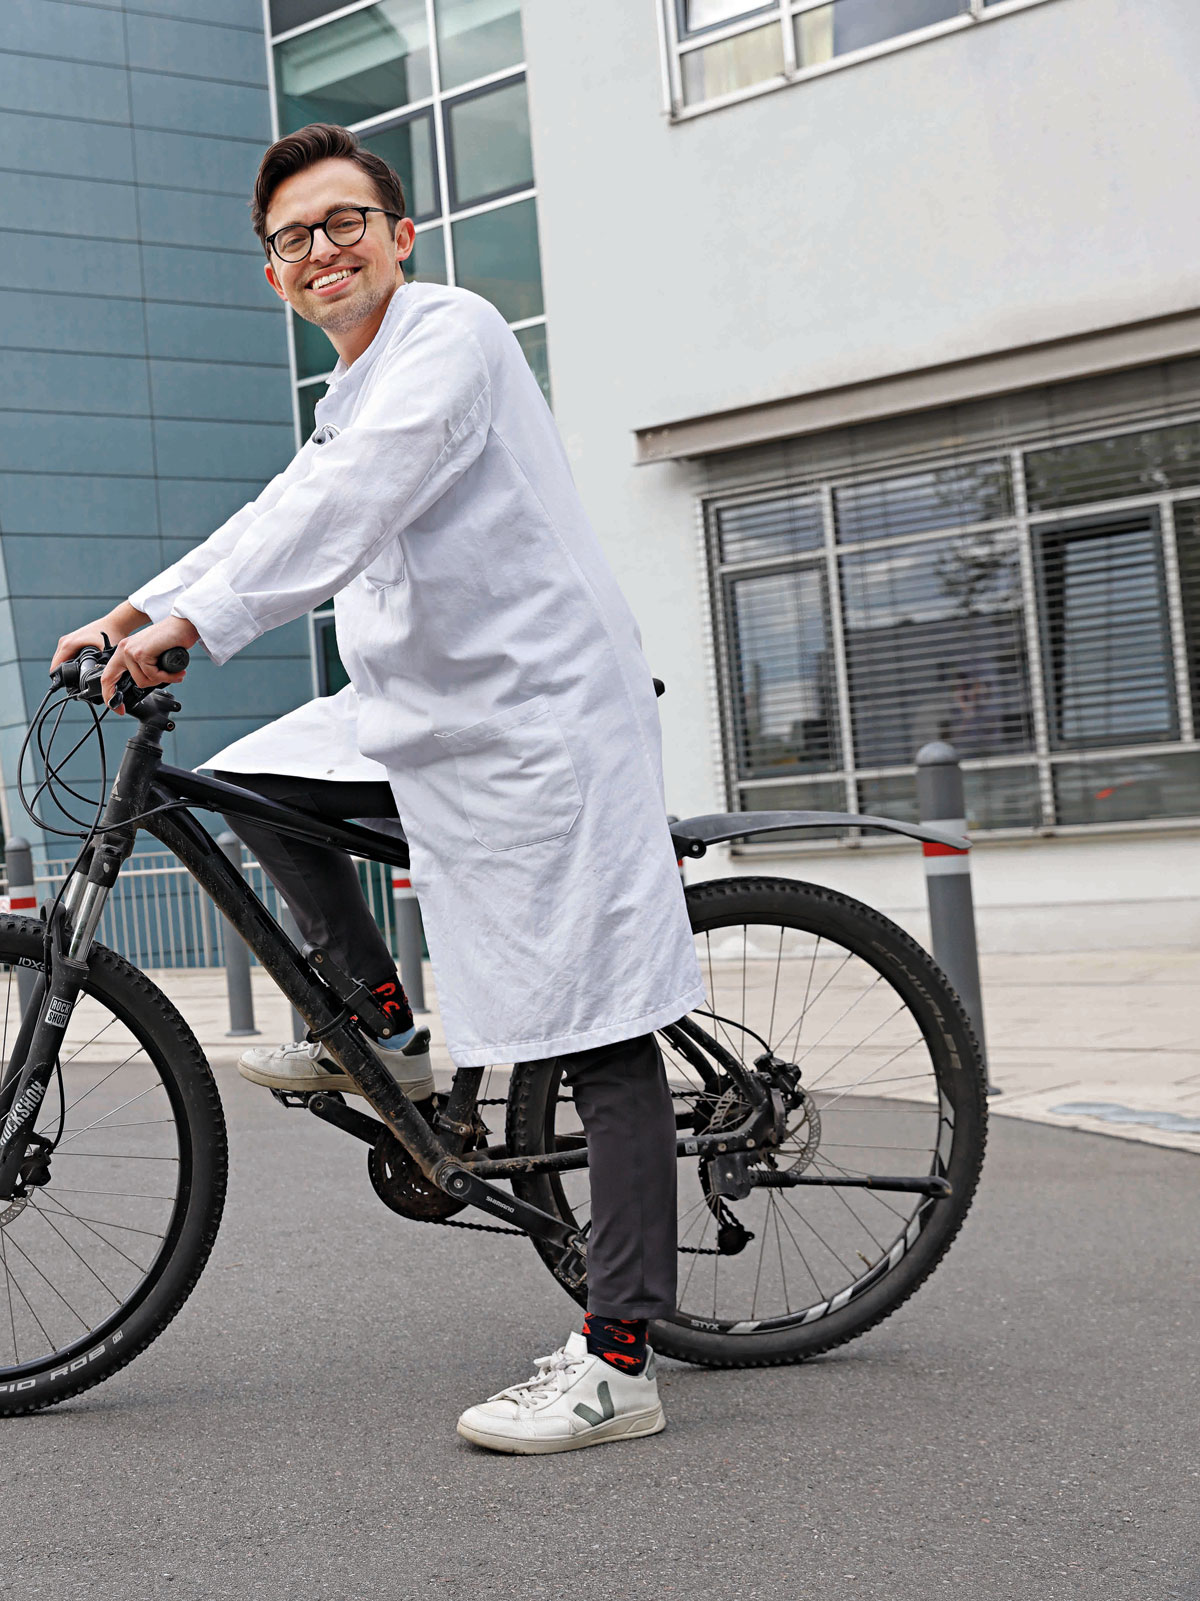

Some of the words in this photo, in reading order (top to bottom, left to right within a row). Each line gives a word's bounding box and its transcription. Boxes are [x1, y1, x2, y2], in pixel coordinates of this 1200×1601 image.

[51, 999, 71, 1014] ROCK
[47, 1011, 67, 1026] SHOX
[50, 1344, 106, 1381] ROB
